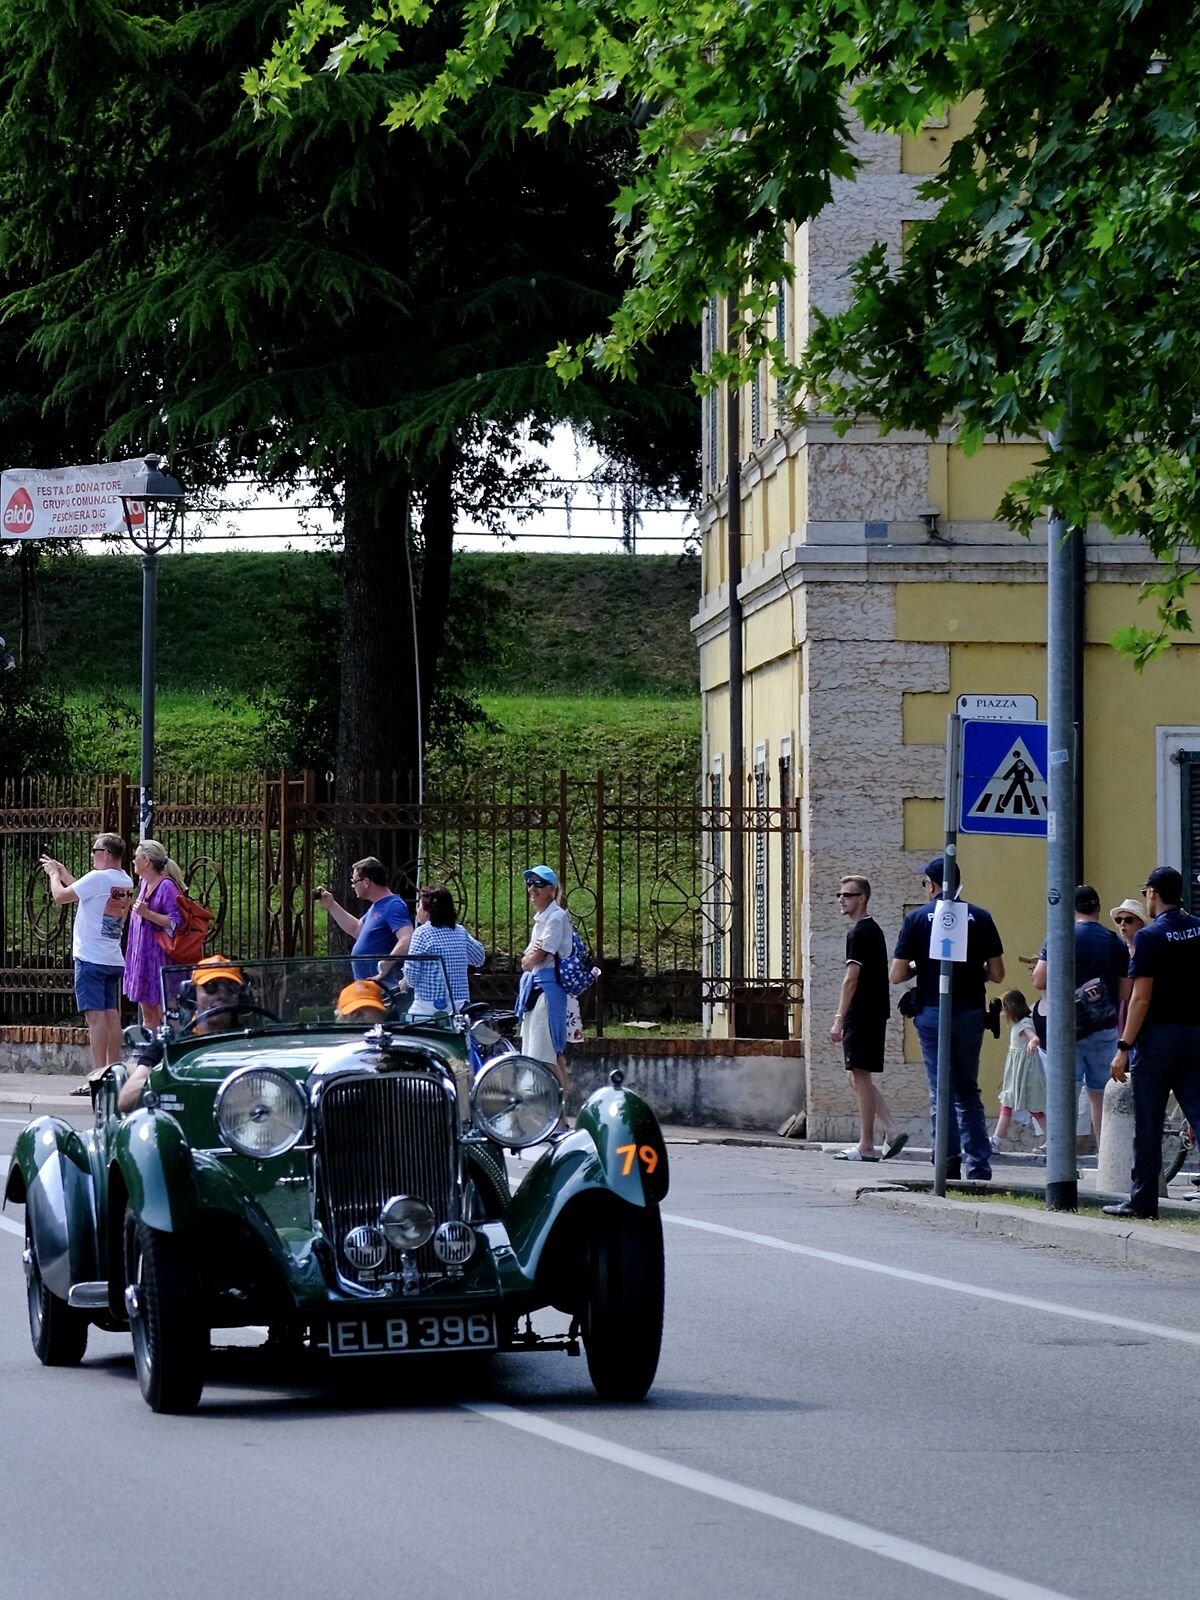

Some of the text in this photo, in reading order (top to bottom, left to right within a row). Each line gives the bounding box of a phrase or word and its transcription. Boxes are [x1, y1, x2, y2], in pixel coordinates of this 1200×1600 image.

[37, 486, 64, 496] FESTA
[76, 480, 122, 494] DONATORE
[72, 495, 118, 507] COMUNALE
[5, 505, 33, 524] aido
[58, 524, 88, 536] MAGGIO
[976, 699, 1017, 708] PIAZZA
[616, 1144, 658, 1176] 79
[337, 1314, 490, 1351] ELB 396
